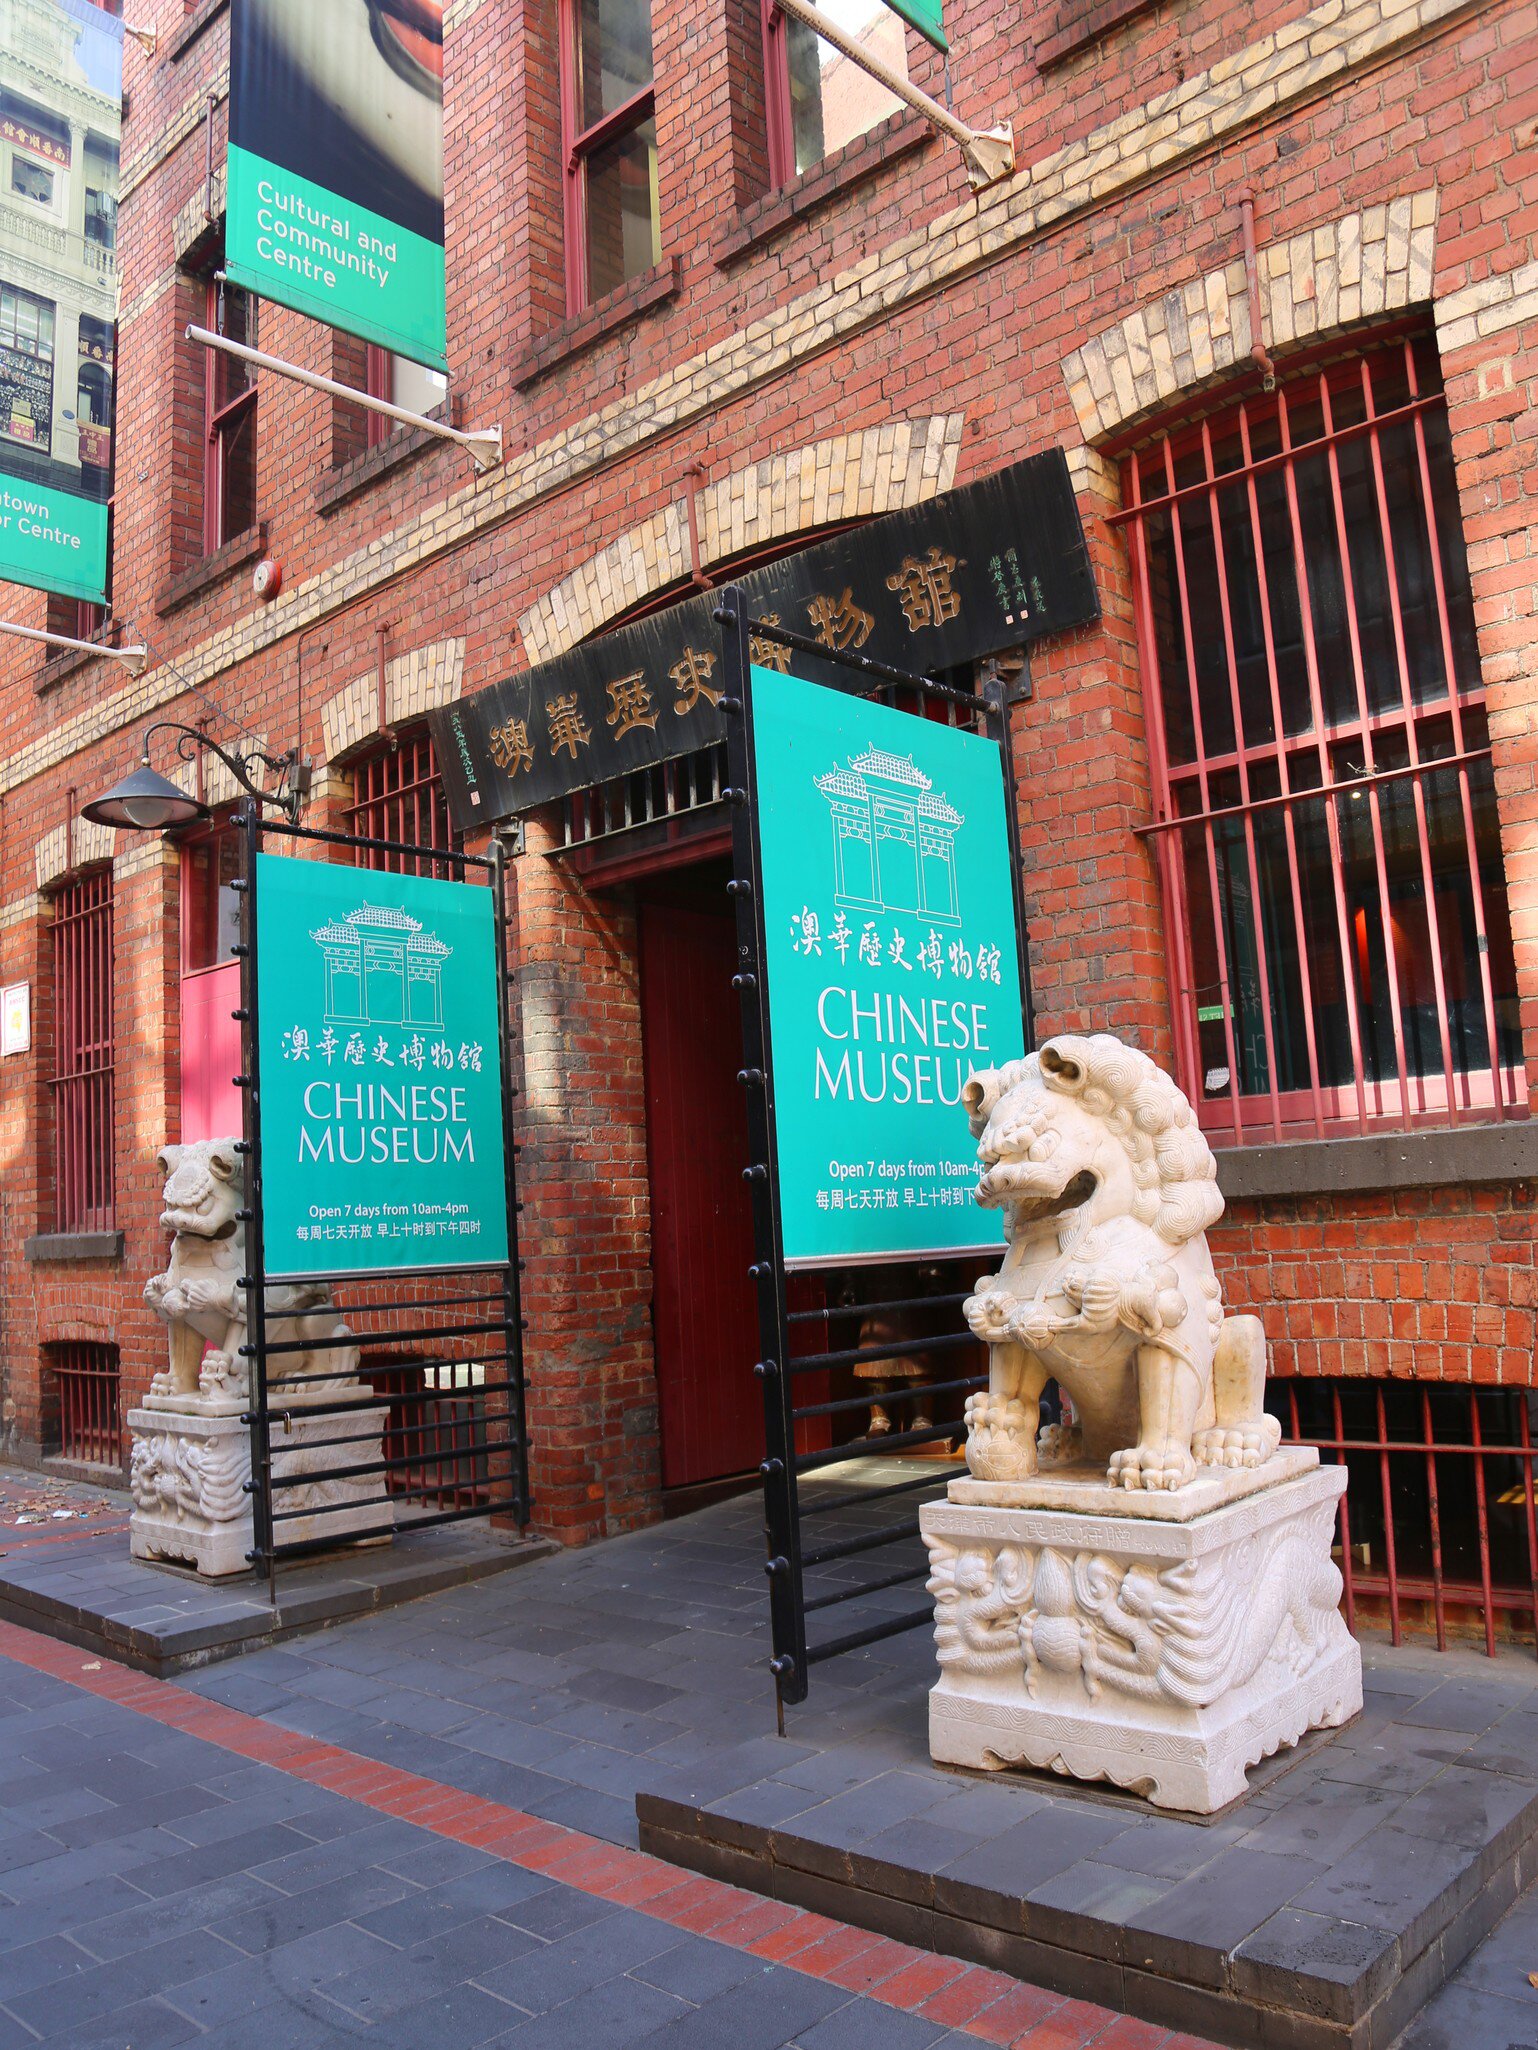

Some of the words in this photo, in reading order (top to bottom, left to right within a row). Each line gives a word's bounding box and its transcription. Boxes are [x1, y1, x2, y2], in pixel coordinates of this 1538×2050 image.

[257, 181, 350, 240] Cultural
[358, 231, 397, 262] and
[257, 209, 389, 288] Community
[257, 237, 337, 288] Centre
[0, 491, 49, 519] town
[18, 517, 81, 549] Centre
[817, 986, 990, 1051] CHINESE
[303, 1081, 467, 1122] CHINESE
[298, 1126, 475, 1163] MUSEUM
[829, 1160, 864, 1181] Open
[867, 1162, 875, 1177] 7
[878, 1160, 906, 1181] days
[908, 1160, 936, 1176] from
[939, 1161, 985, 1177] 10am-4p
[309, 1205, 341, 1221] Open
[344, 1204, 352, 1217] 7
[354, 1203, 380, 1219] days
[382, 1203, 409, 1216] from
[412, 1202, 469, 1217] 10am-4pm
[816, 1188, 899, 1211] 每周七天开放
[903, 1186, 975, 1208] 早上十时到下
[296, 1224, 373, 1241] 每周七天开放
[377, 1220, 481, 1238] 早上十时到下午四时
